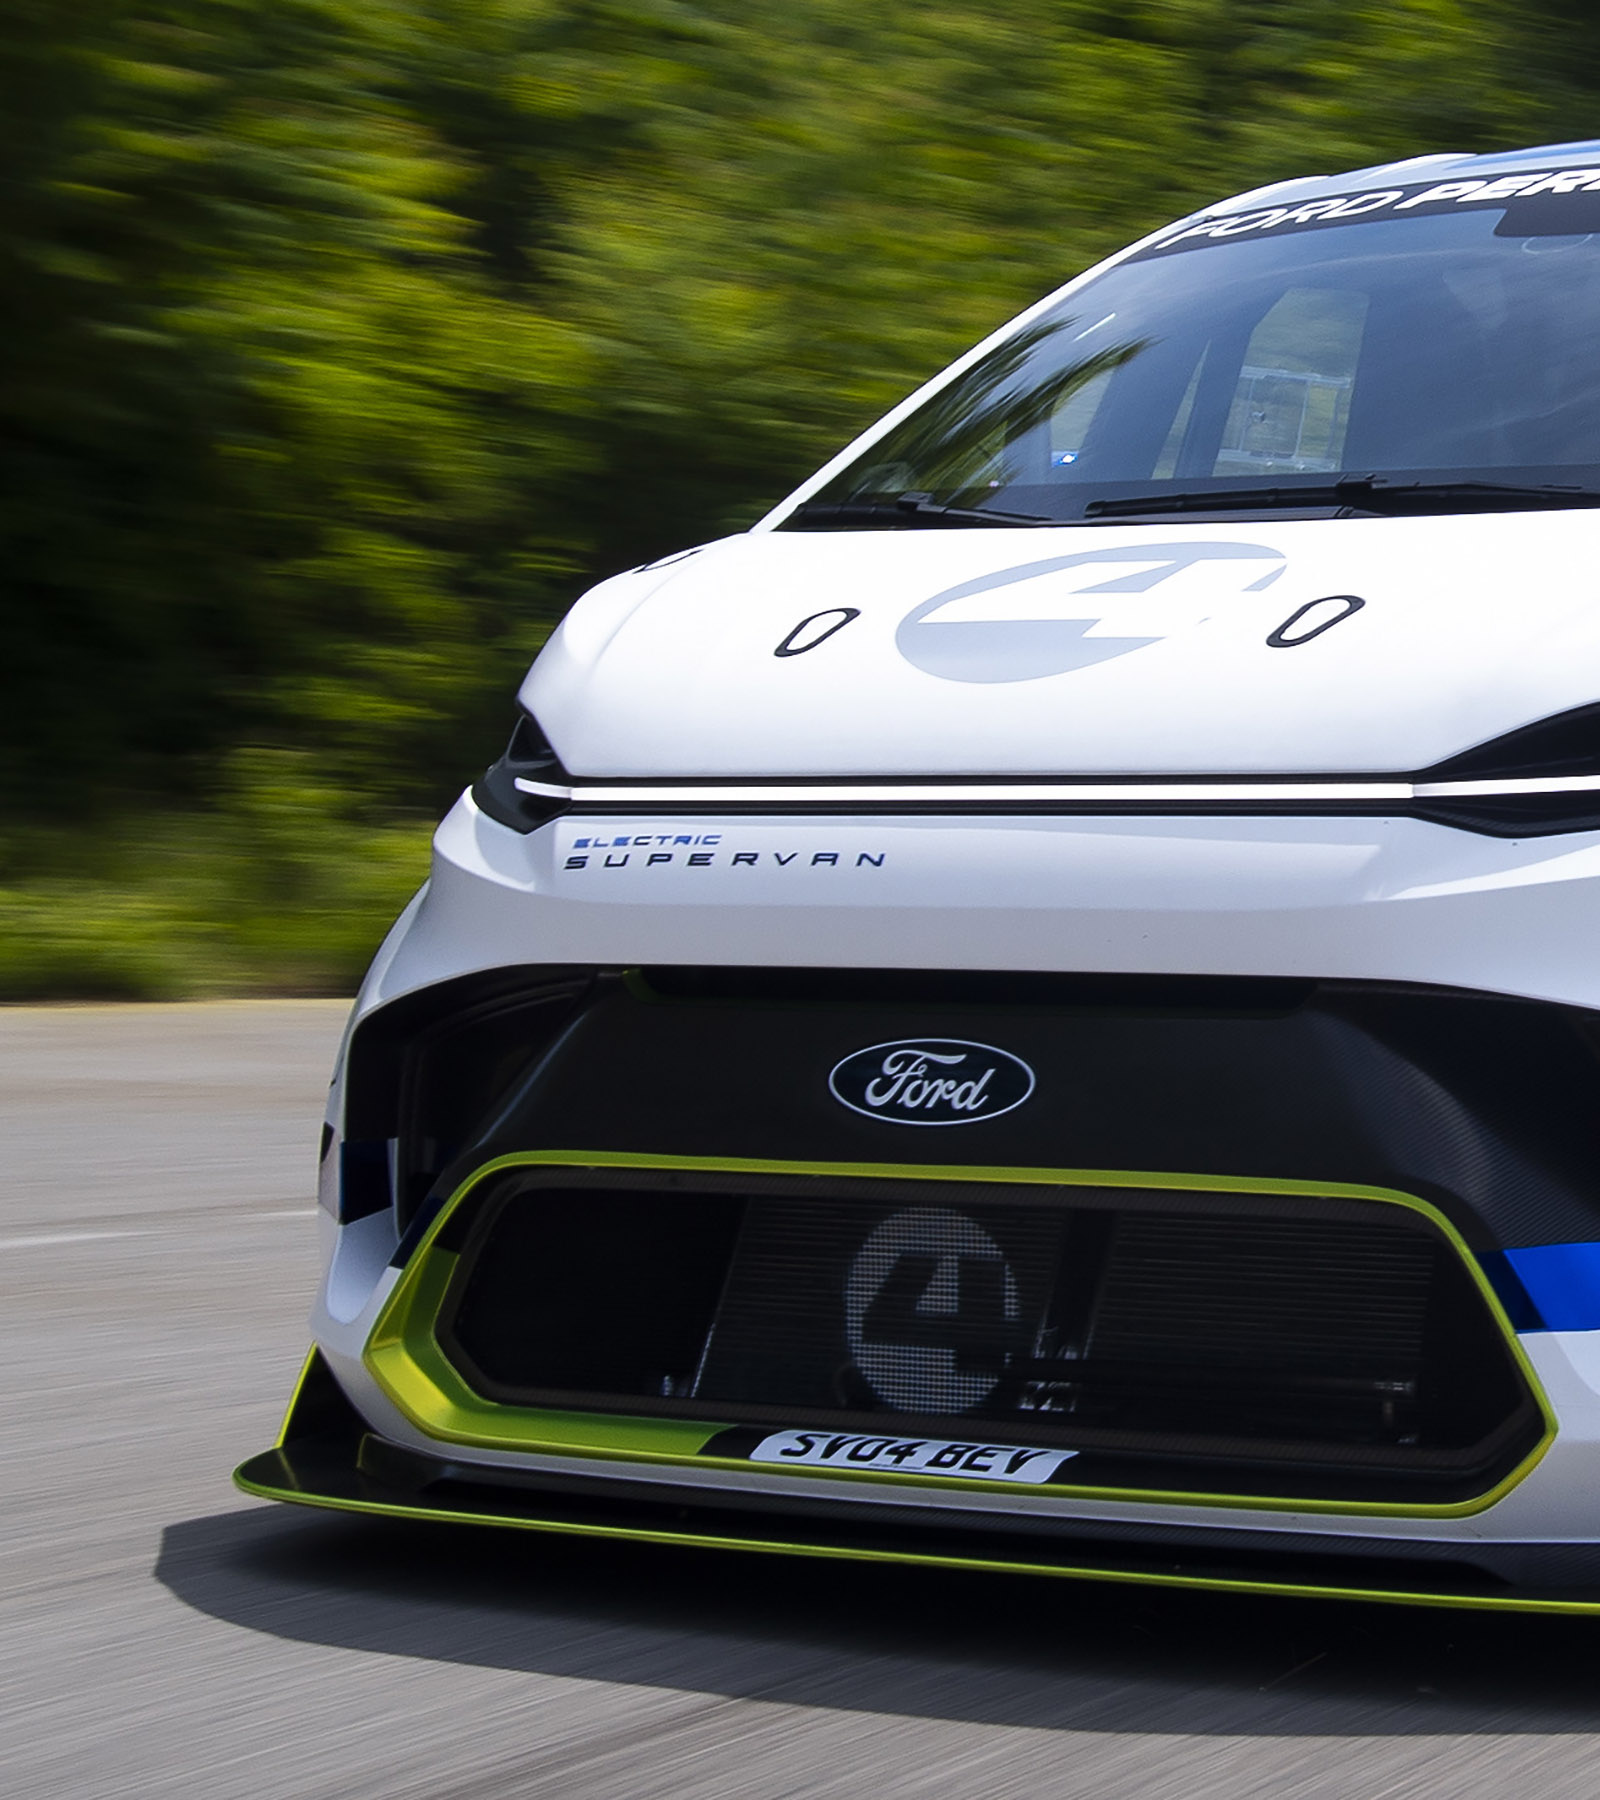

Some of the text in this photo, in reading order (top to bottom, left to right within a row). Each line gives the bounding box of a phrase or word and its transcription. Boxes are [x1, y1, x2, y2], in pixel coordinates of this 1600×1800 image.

[1155, 191, 1403, 249] FORD
[572, 834, 722, 849] ELECTRIC
[564, 852, 886, 870] SUPERVAN
[865, 1049, 996, 1111] Ford
[925, 1446, 1049, 1475] BEV
